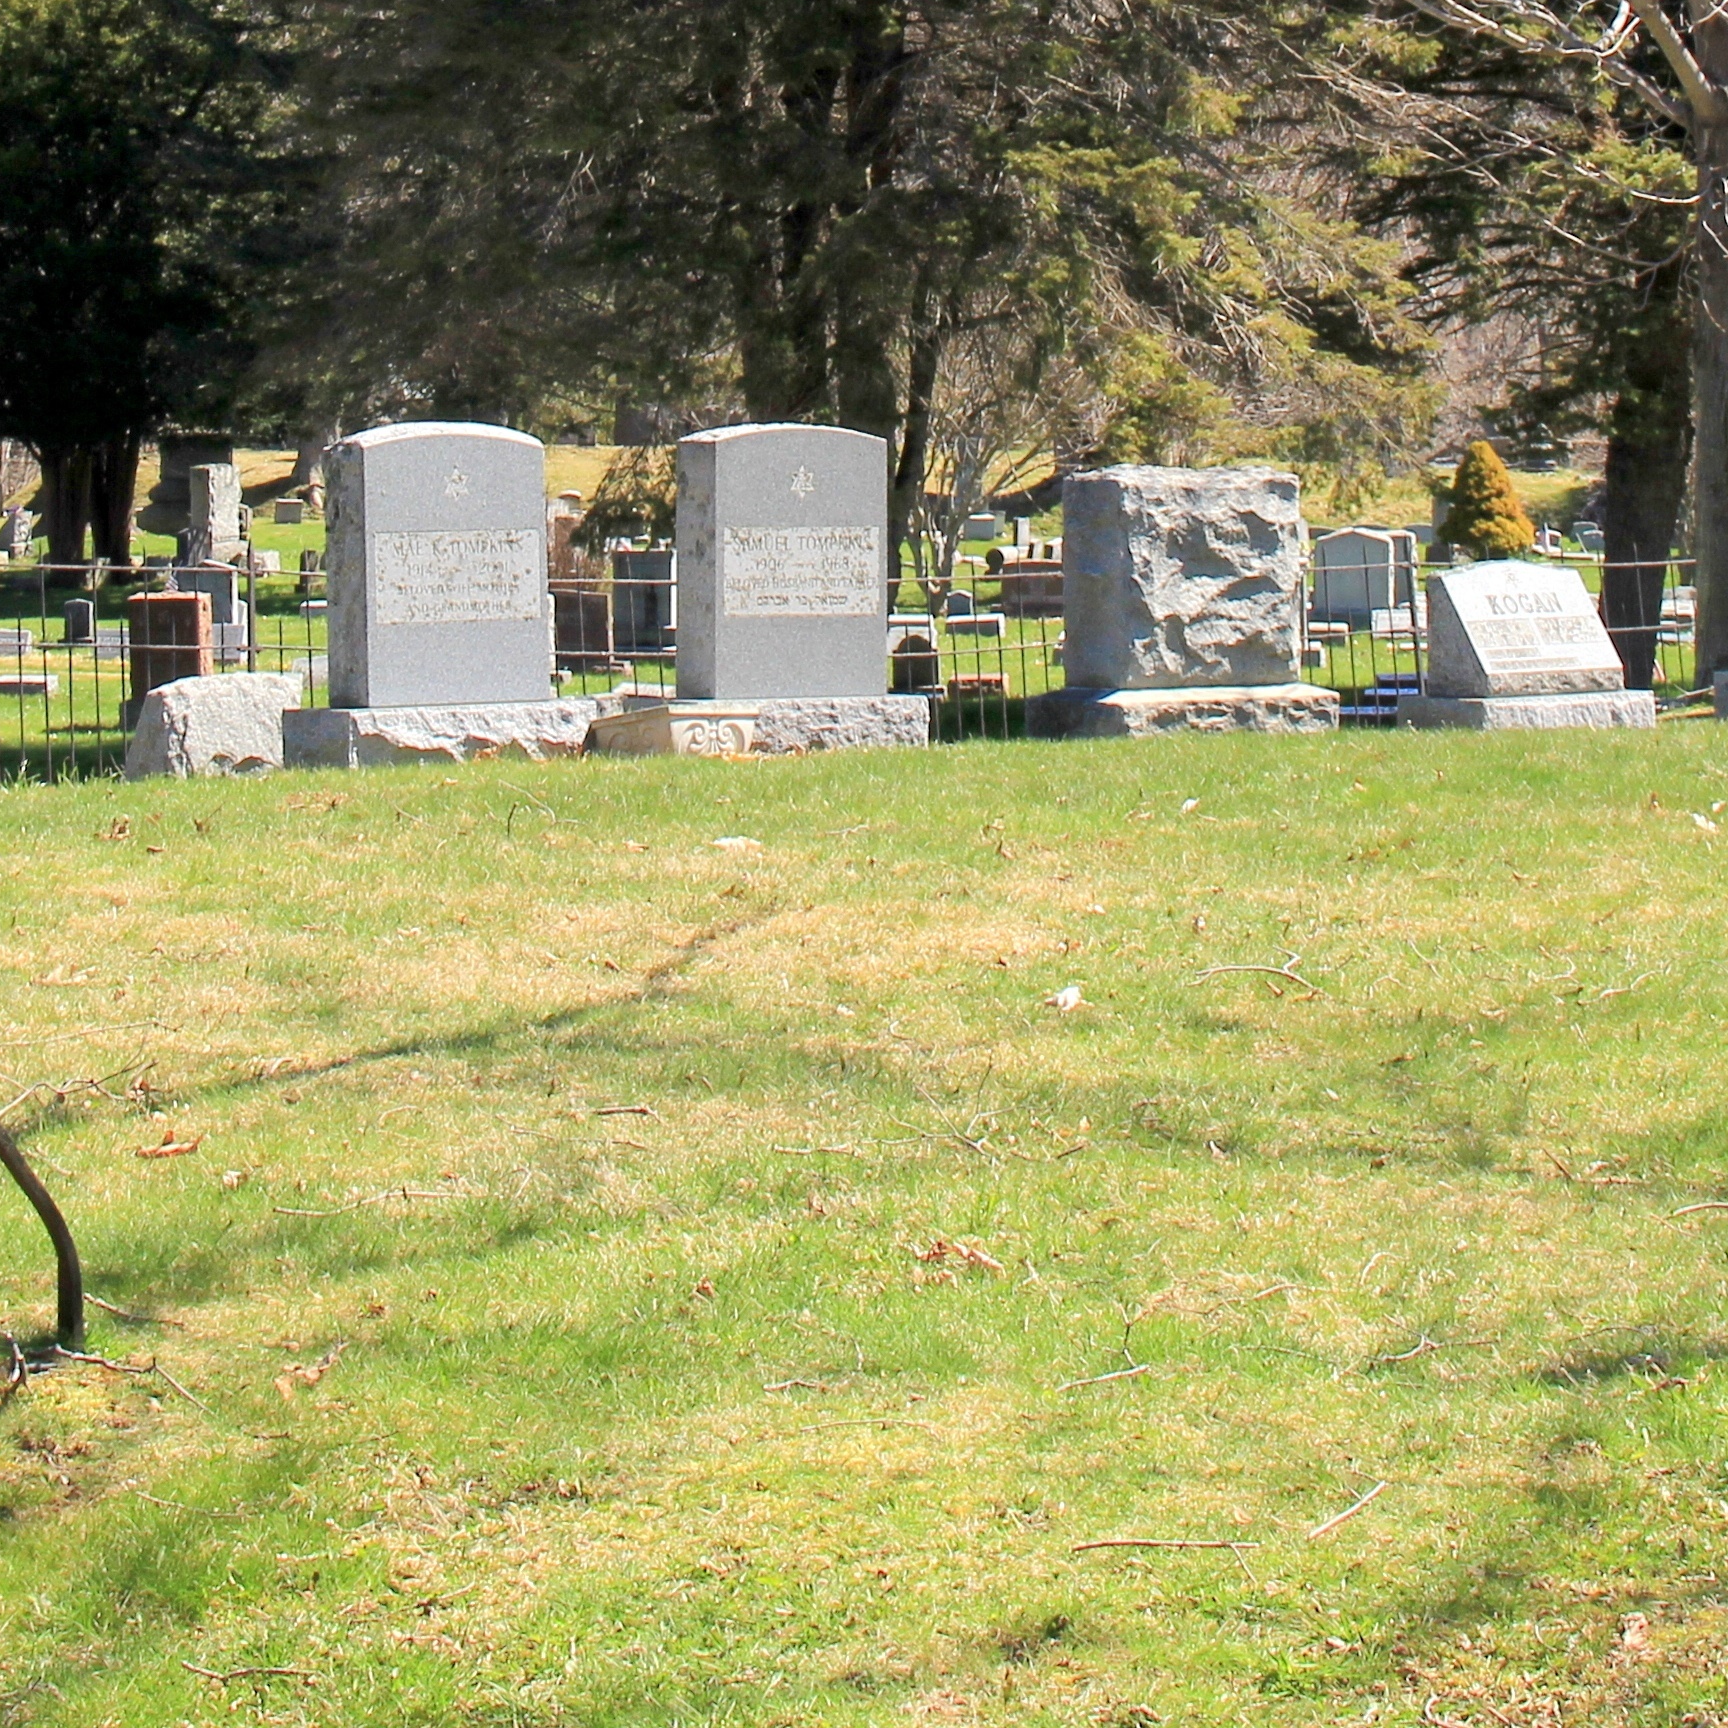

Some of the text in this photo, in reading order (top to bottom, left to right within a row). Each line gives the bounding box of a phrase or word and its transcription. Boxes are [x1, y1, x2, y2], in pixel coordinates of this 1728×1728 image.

[450, 539, 524, 554] TOMPKINS
[732, 535, 873, 552] SAMUEL TOMPKINS
[1484, 592, 1563, 615] KOGAN
